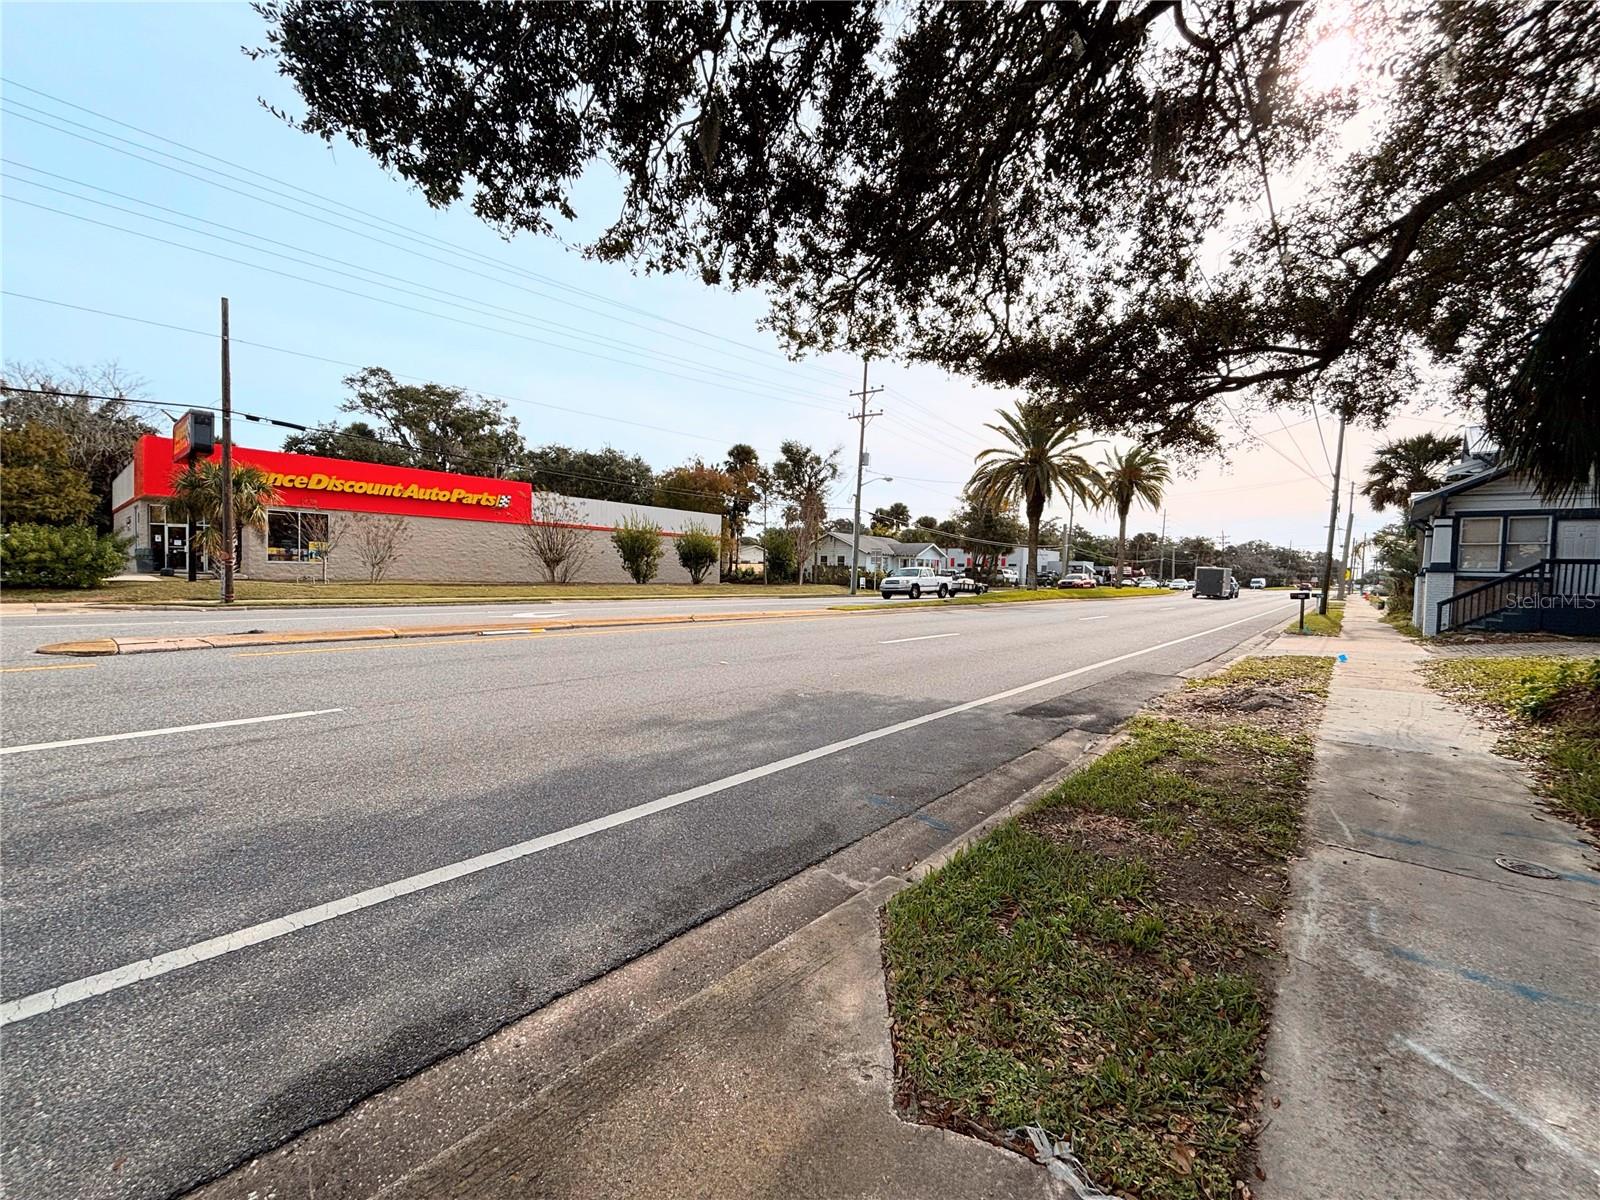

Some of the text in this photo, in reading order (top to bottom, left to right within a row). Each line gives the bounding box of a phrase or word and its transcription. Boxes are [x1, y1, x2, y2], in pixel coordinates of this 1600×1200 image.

[259, 472, 497, 507] ance Discount Auto Parts
